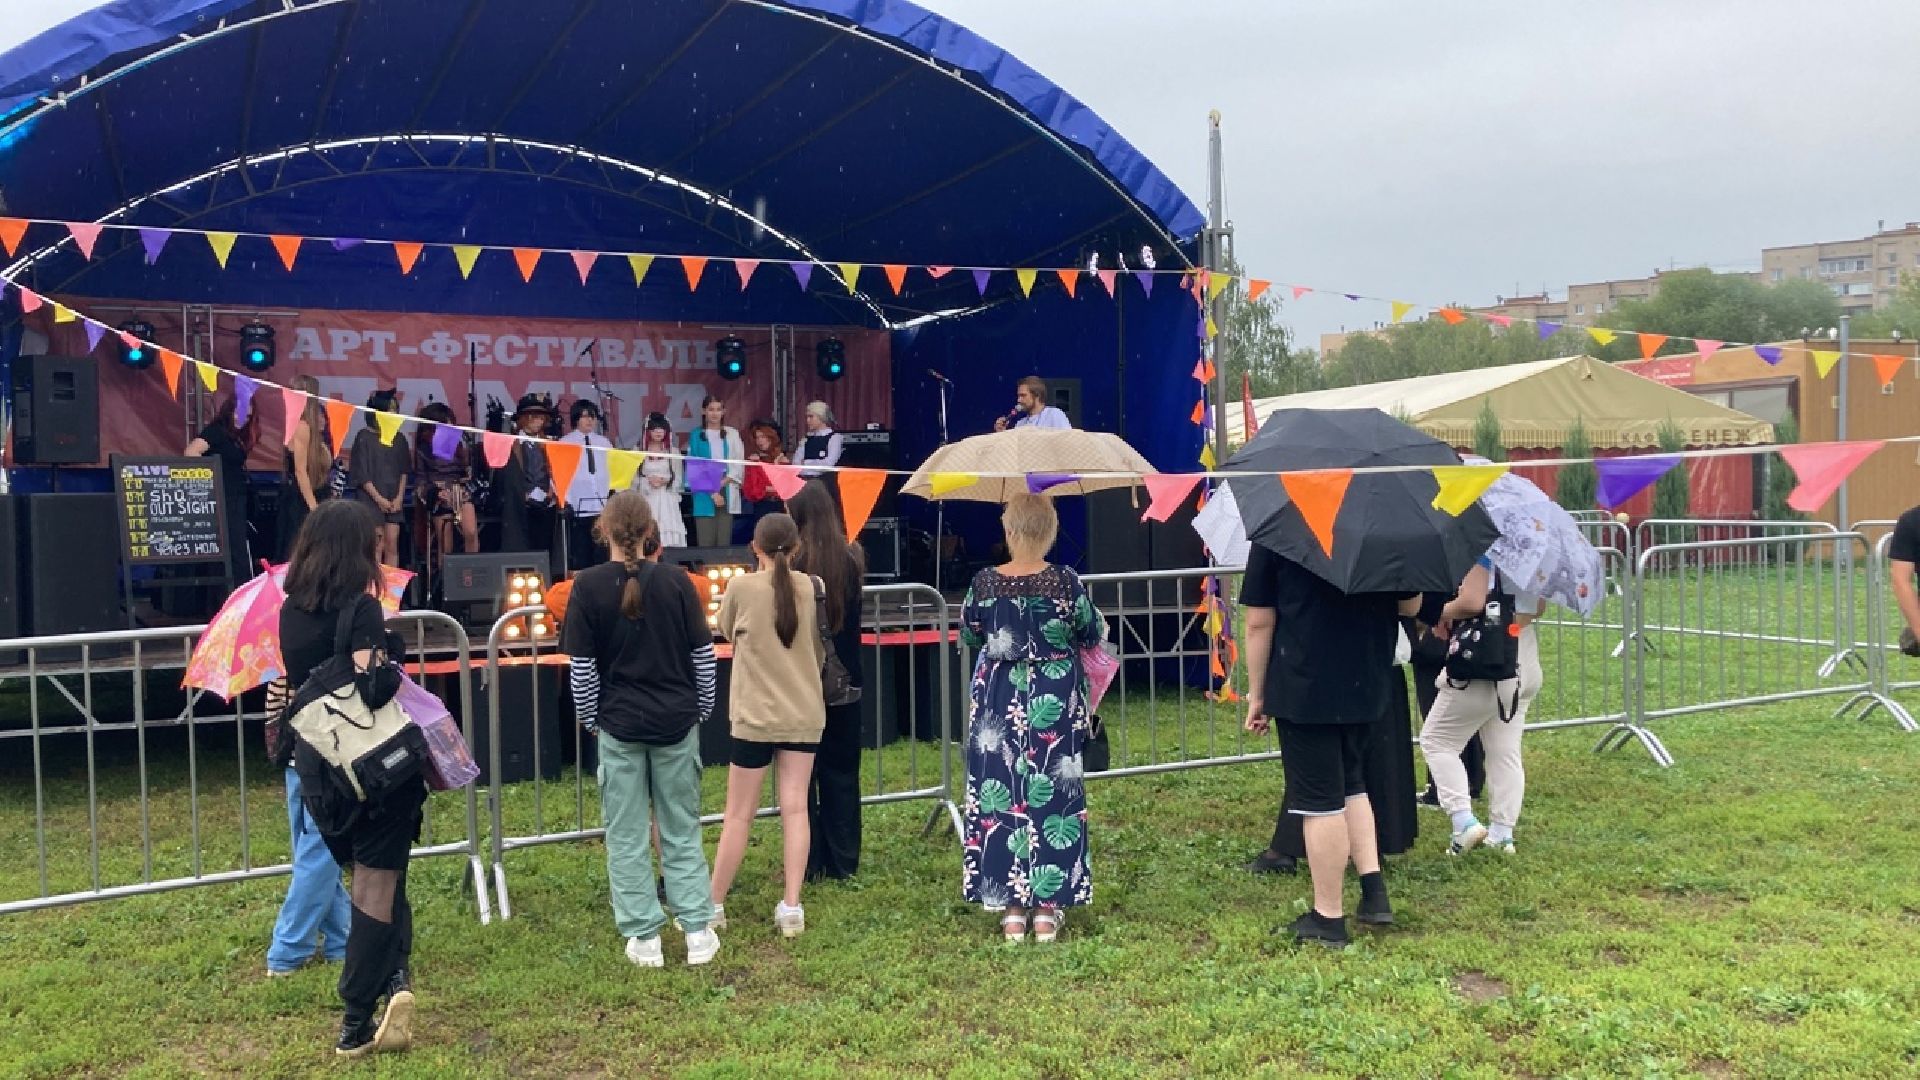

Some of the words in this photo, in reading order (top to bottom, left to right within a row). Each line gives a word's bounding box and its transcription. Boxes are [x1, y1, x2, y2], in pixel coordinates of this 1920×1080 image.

[288, 326, 718, 371] АРТ-ФЕСТИВАЛЬ
[150, 502, 174, 515] OUT
[178, 501, 216, 514] SIGHT
